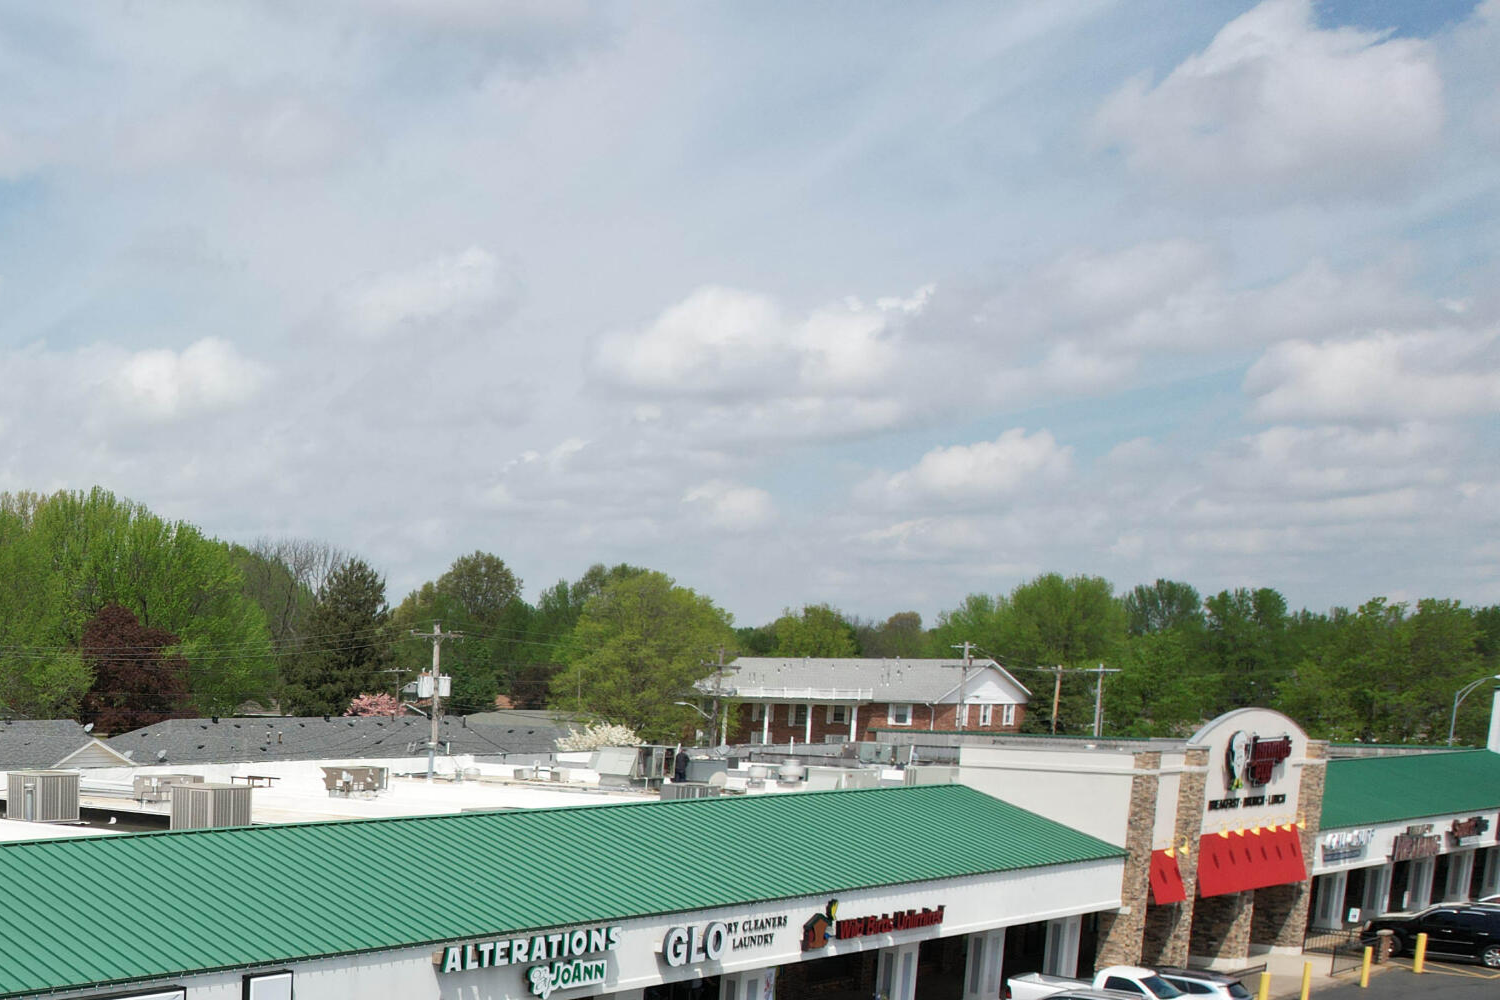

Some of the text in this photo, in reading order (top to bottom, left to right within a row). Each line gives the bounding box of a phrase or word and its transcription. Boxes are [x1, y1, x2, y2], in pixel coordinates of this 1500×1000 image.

[742, 915, 788, 932] CLEANERS
[441, 926, 622, 973] ALTERATIONS
[662, 921, 727, 967] GLO
[732, 932, 774, 950] LAUNDRY
